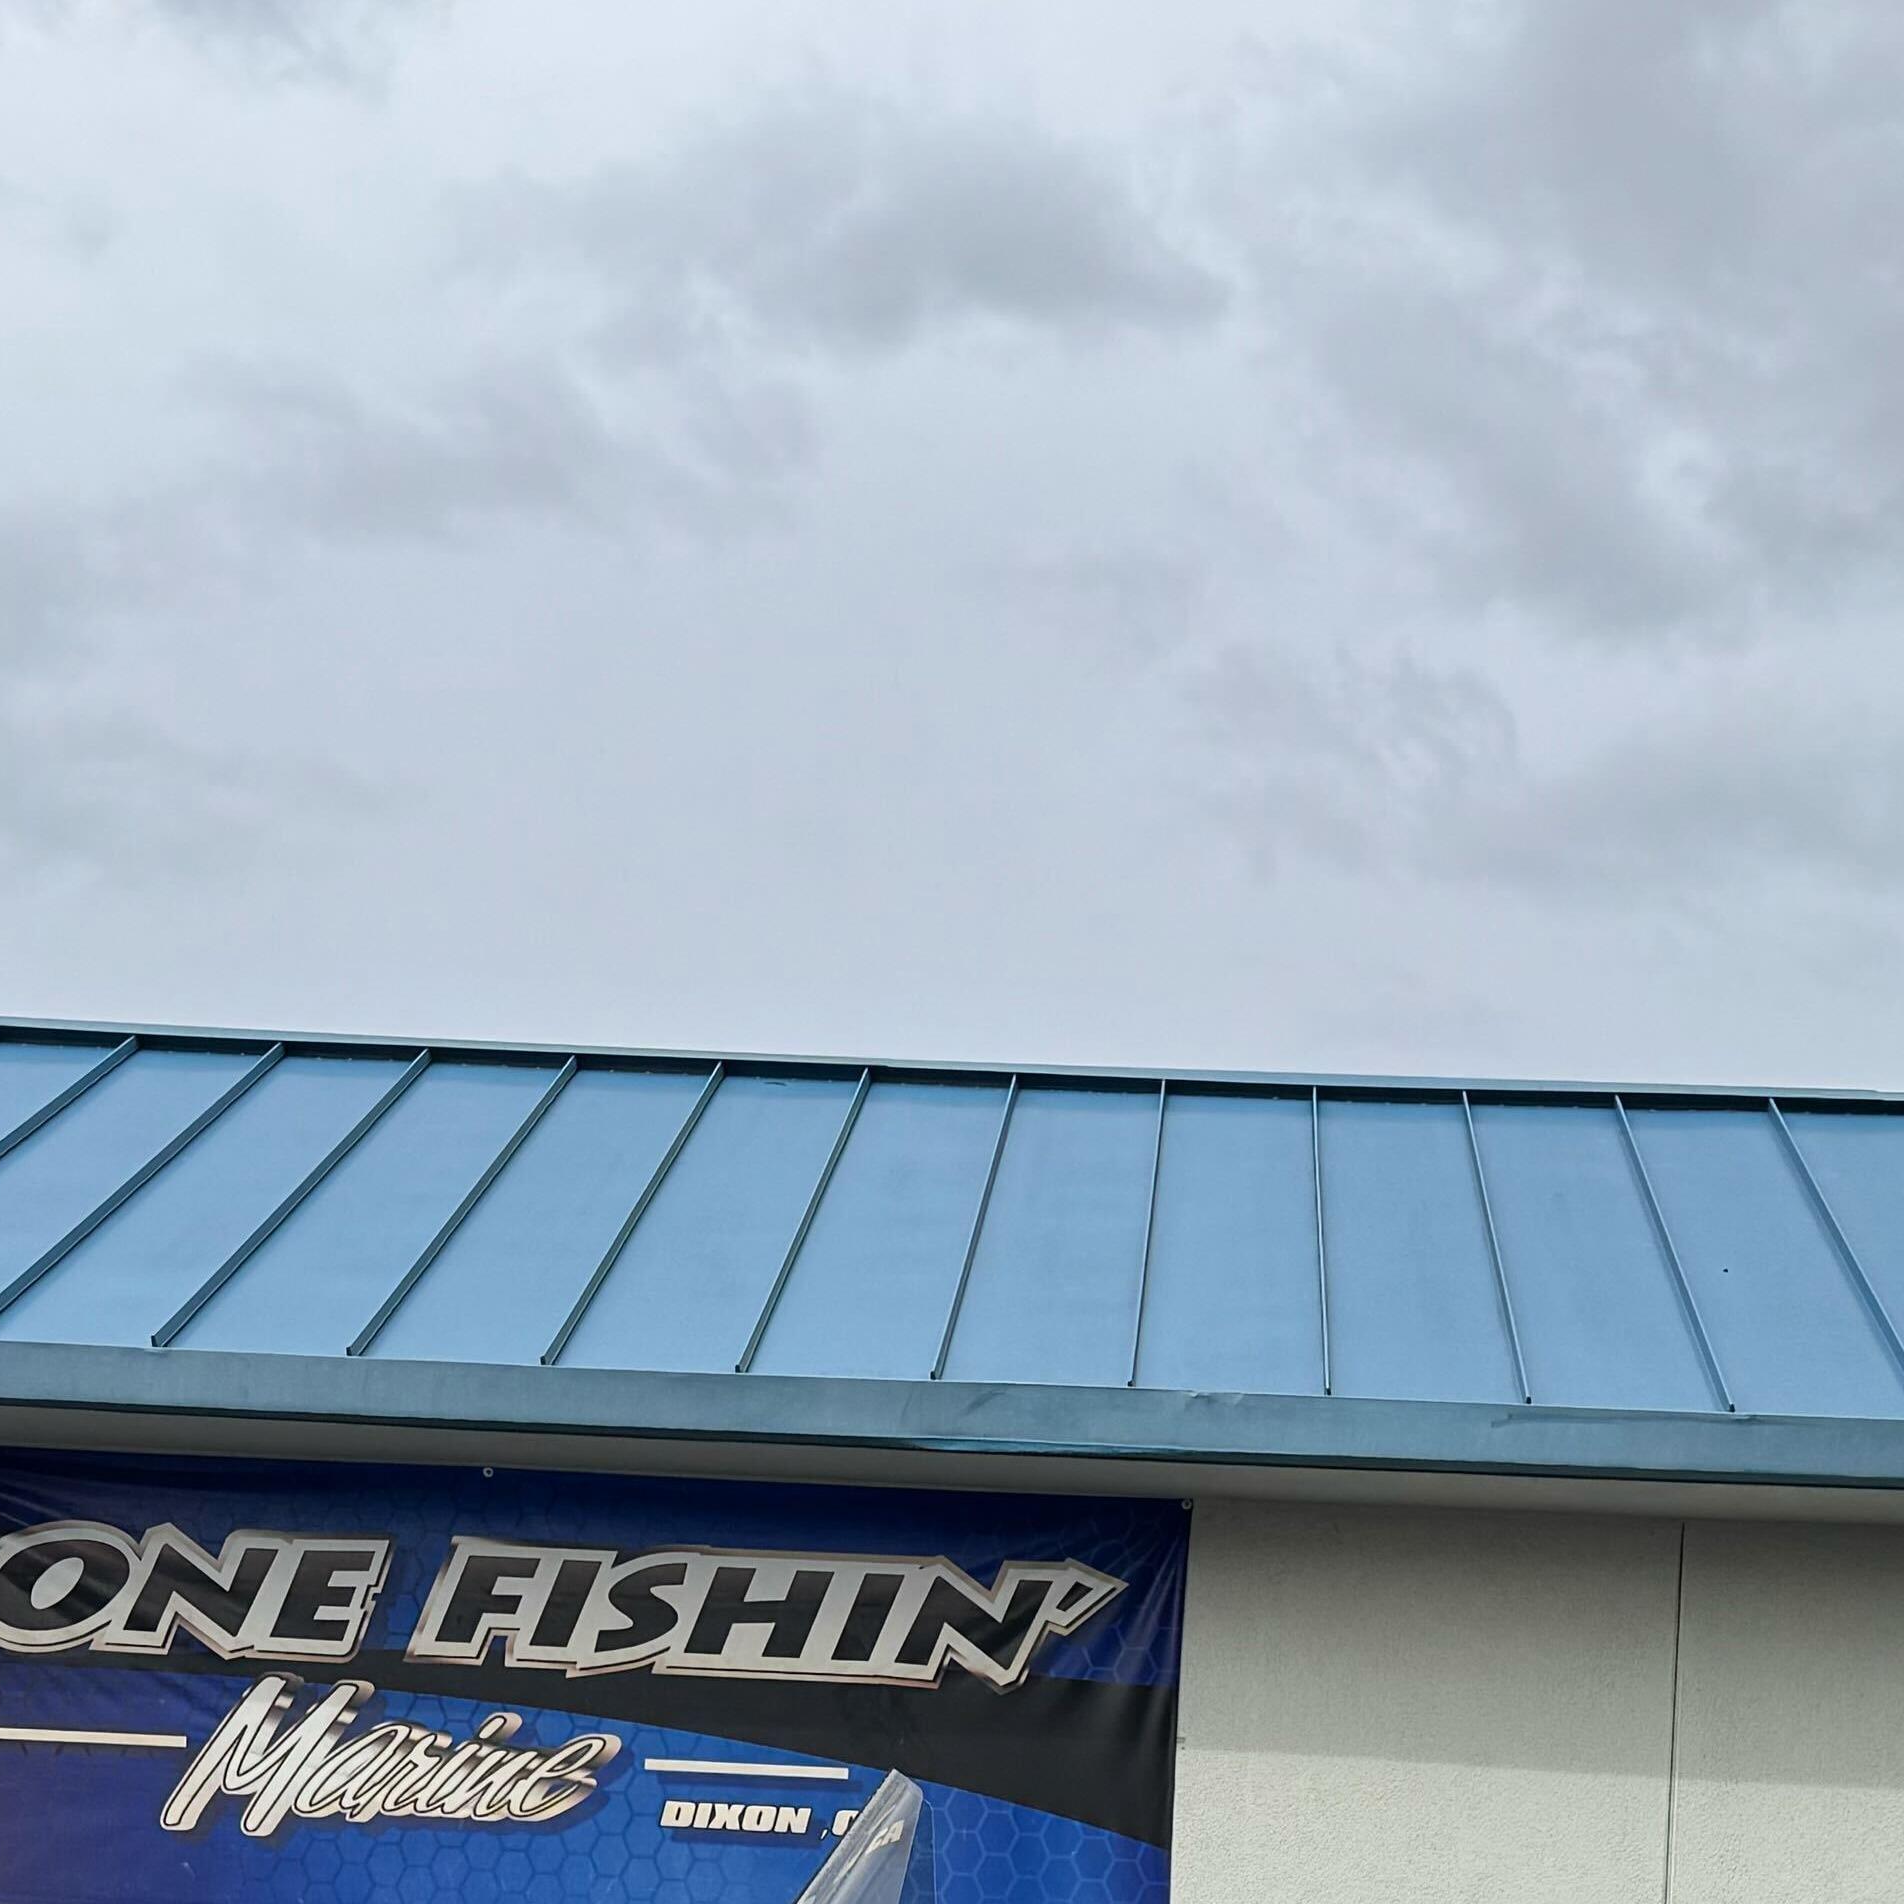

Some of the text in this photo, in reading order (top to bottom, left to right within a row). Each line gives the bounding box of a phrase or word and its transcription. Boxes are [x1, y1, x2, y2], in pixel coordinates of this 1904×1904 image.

[404, 1535, 1131, 1693] FISHIN'
[161, 1673, 622, 1837] Marine
[658, 1799, 812, 1834] DIXON
